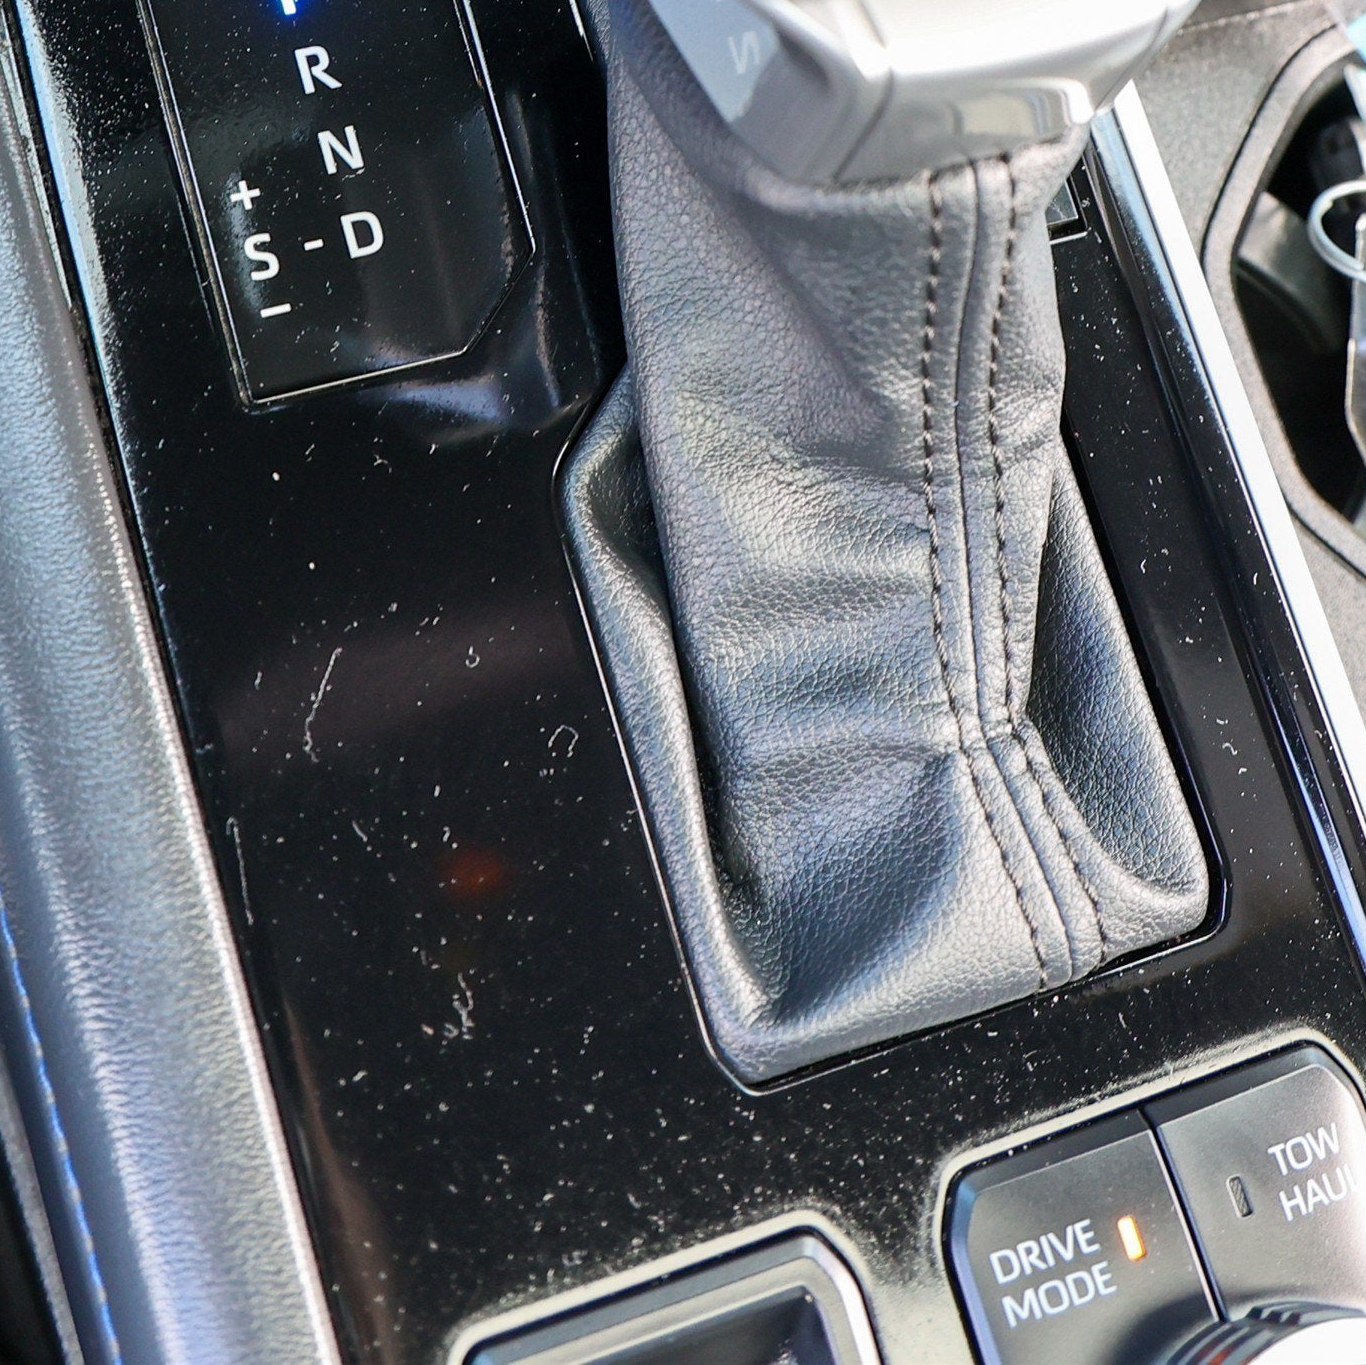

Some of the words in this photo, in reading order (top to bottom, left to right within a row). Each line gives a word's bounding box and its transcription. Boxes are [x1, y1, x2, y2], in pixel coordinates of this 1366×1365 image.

[294, 45, 342, 95] R
[317, 125, 365, 175] N
[243, 232, 281, 281] S
[340, 211, 385, 259] D
[1268, 1122, 1341, 1176] TOW
[989, 1218, 1101, 1285] DRIVE
[1001, 1260, 1118, 1329] MODE
